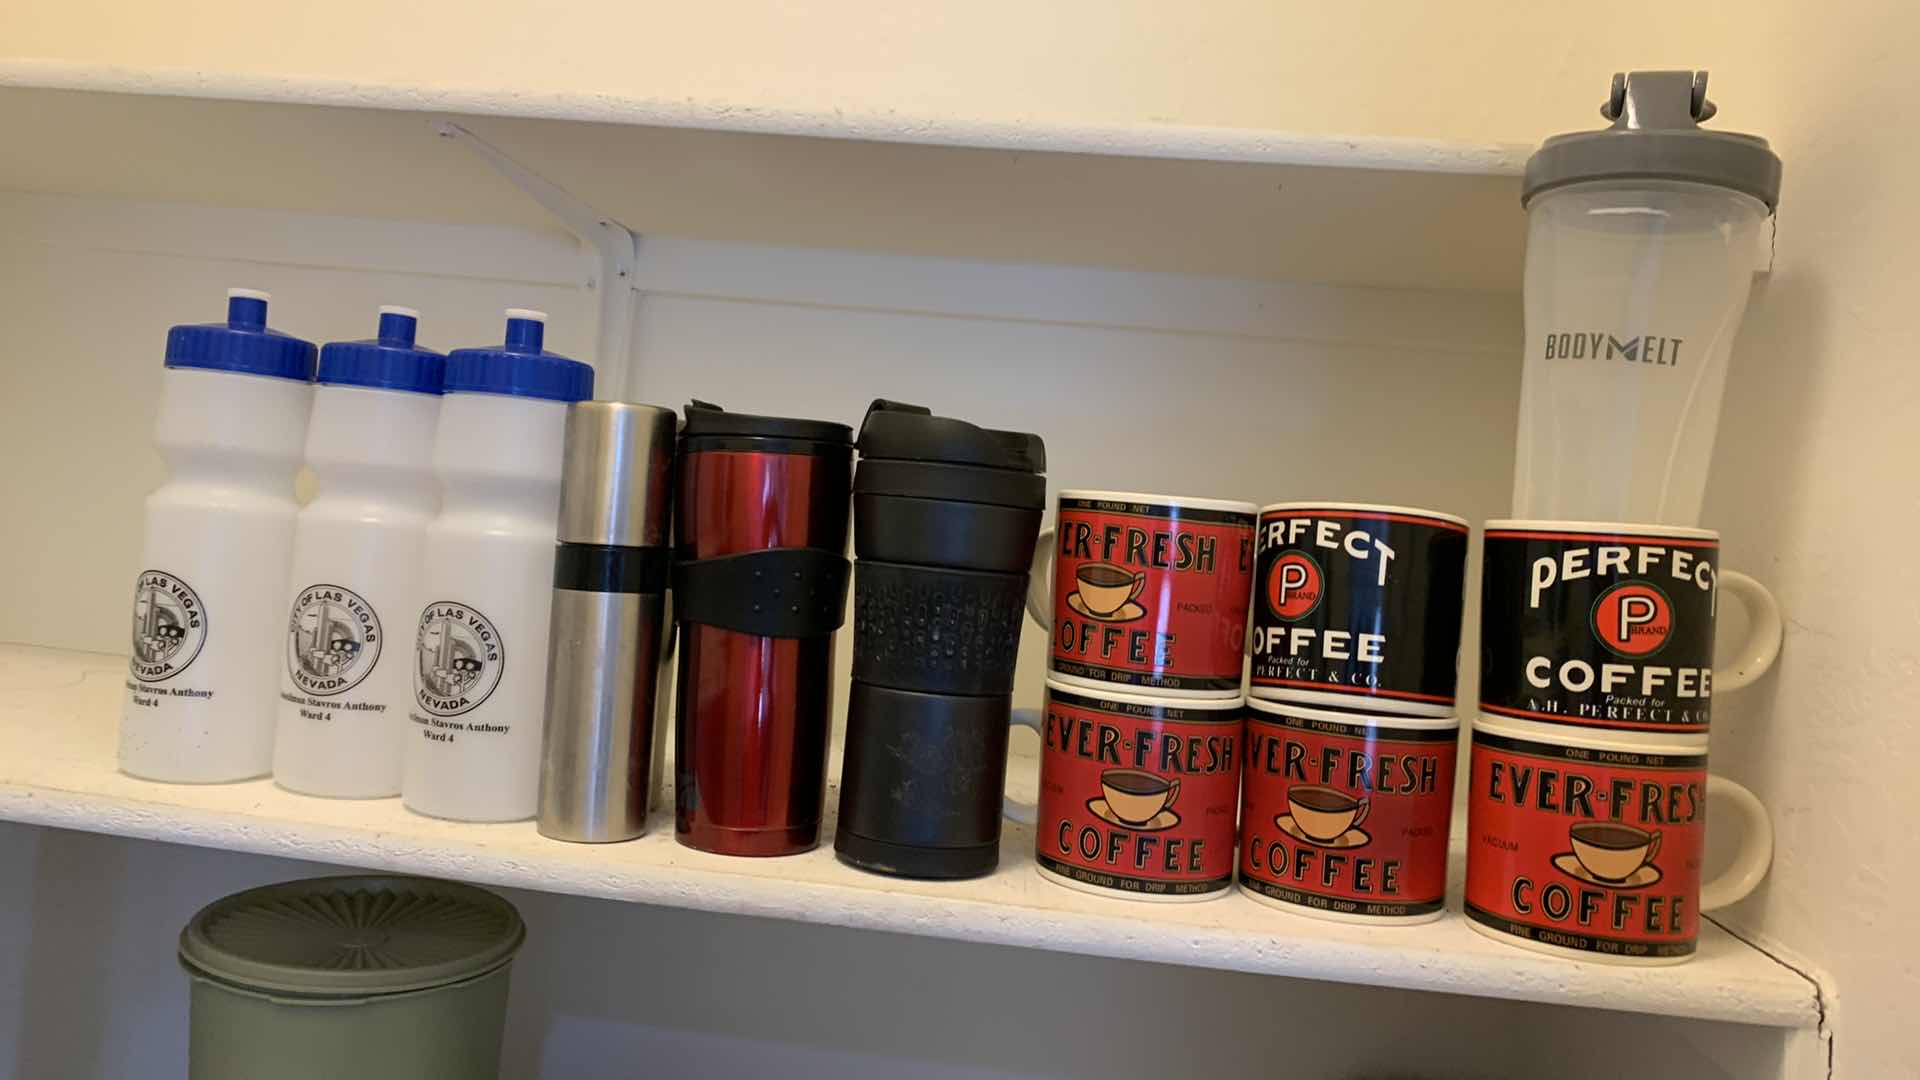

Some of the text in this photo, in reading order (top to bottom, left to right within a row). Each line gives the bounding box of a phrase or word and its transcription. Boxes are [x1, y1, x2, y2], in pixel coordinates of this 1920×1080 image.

[1097, 501, 1127, 512] POUND
[1133, 504, 1150, 513] NET
[1279, 563, 1307, 606] P
[145, 576, 168, 588] LAS
[171, 584, 200, 629] VEGAS
[315, 590, 343, 602] LAS
[346, 599, 376, 644] VEGAS
[1617, 595, 1658, 644] P
[437, 607, 464, 620] LAS
[468, 616, 498, 662] VEGAS
[1630, 625, 1667, 636] BRAND
[1268, 655, 1310, 667] Packed for
[295, 669, 348, 690] NEVADA
[1088, 667, 1107, 680] FOR
[1111, 671, 1132, 683] DRIP
[1141, 675, 1182, 687] METHOD
[1328, 671, 1339, 682] &
[1351, 672, 1382, 687] CO.
[1525, 656, 1712, 698] COFFEE
[169, 687, 214, 700] Anthony
[307, 696, 341, 710] Stavros
[343, 700, 387, 713] Anthony
[417, 688, 470, 711] NEVADA
[1605, 695, 1665, 708] Packed for
[300, 708, 332, 722] Ward 4
[1100, 700, 1185, 719] ONE POUND NET
[1528, 698, 1568, 714] A.H.
[1579, 703, 1674, 722] PERFECT
[1681, 710, 1691, 723] &
[423, 728, 455, 743] Ward 4
[430, 717, 464, 731] Stavros
[466, 722, 511, 735] Anthony
[1285, 717, 1305, 729] ONE
[1311, 720, 1346, 733] POUND
[1046, 711, 1234, 775] EVER-FRESH
[1247, 731, 1439, 796] VER-FRESH
[1566, 748, 1665, 766] ONE POUND NET
[1057, 818, 1206, 874] COFFEE
[1251, 835, 1402, 896] COFFEE
[1074, 869, 1114, 887] GROUND
[1120, 880, 1140, 891] FOR
[1145, 882, 1168, 893] DRIP
[1175, 883, 1209, 894] METHOD
[1265, 885, 1302, 902] GROUND
[1308, 896, 1328, 909] FOR
[1333, 900, 1357, 913] DRIP
[1367, 904, 1407, 916] METHOD
[1512, 876, 1684, 934] COFFEE
[1509, 924, 1532, 940] FINE
[1538, 928, 1588, 948] GROUND
[1596, 941, 1619, 953] FOR
